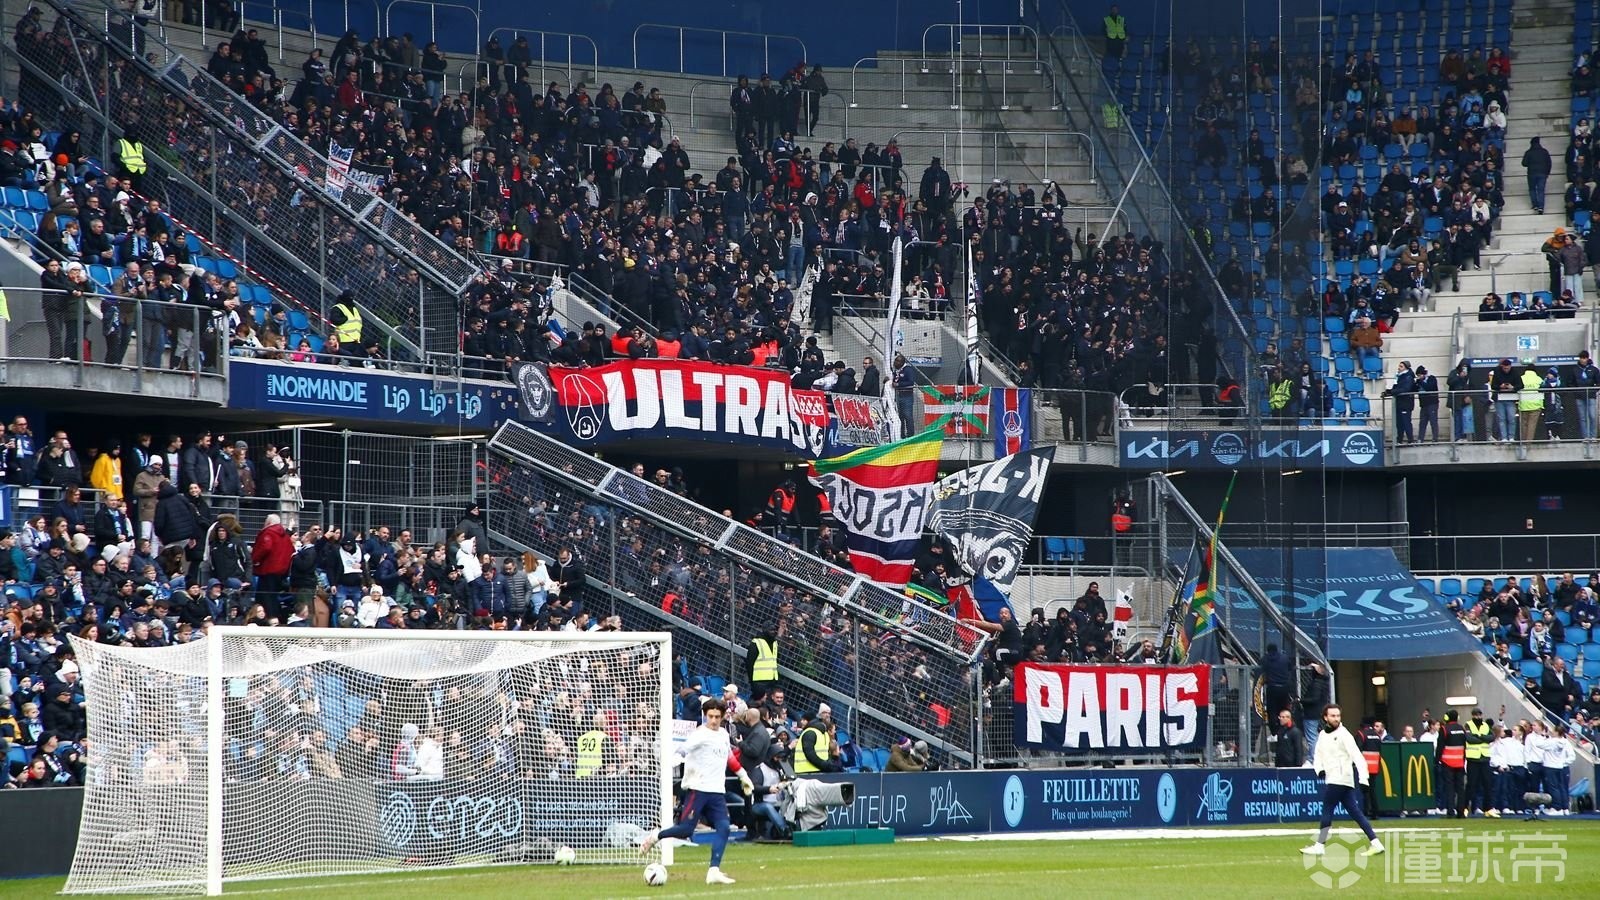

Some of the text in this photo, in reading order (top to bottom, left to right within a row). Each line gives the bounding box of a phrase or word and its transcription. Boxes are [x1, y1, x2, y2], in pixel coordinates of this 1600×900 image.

[271, 374, 368, 403] NORMANDIE
[602, 367, 806, 450] ULTRAS
[1127, 440, 1198, 459] KIA
[1258, 439, 1329, 458] KIA
[1306, 572, 1407, 584] commercial
[1367, 610, 1441, 622] vauban
[1024, 667, 1199, 749] PARIS
[1042, 778, 1141, 803] FEUILLETTE
[1252, 779, 1284, 794] CASINO
[825, 794, 907, 826] RAITEUR
[1051, 808, 1066, 821] Plus
[1067, 808, 1090, 822] qu'une
[1244, 801, 1301, 817] RESTAURANT
